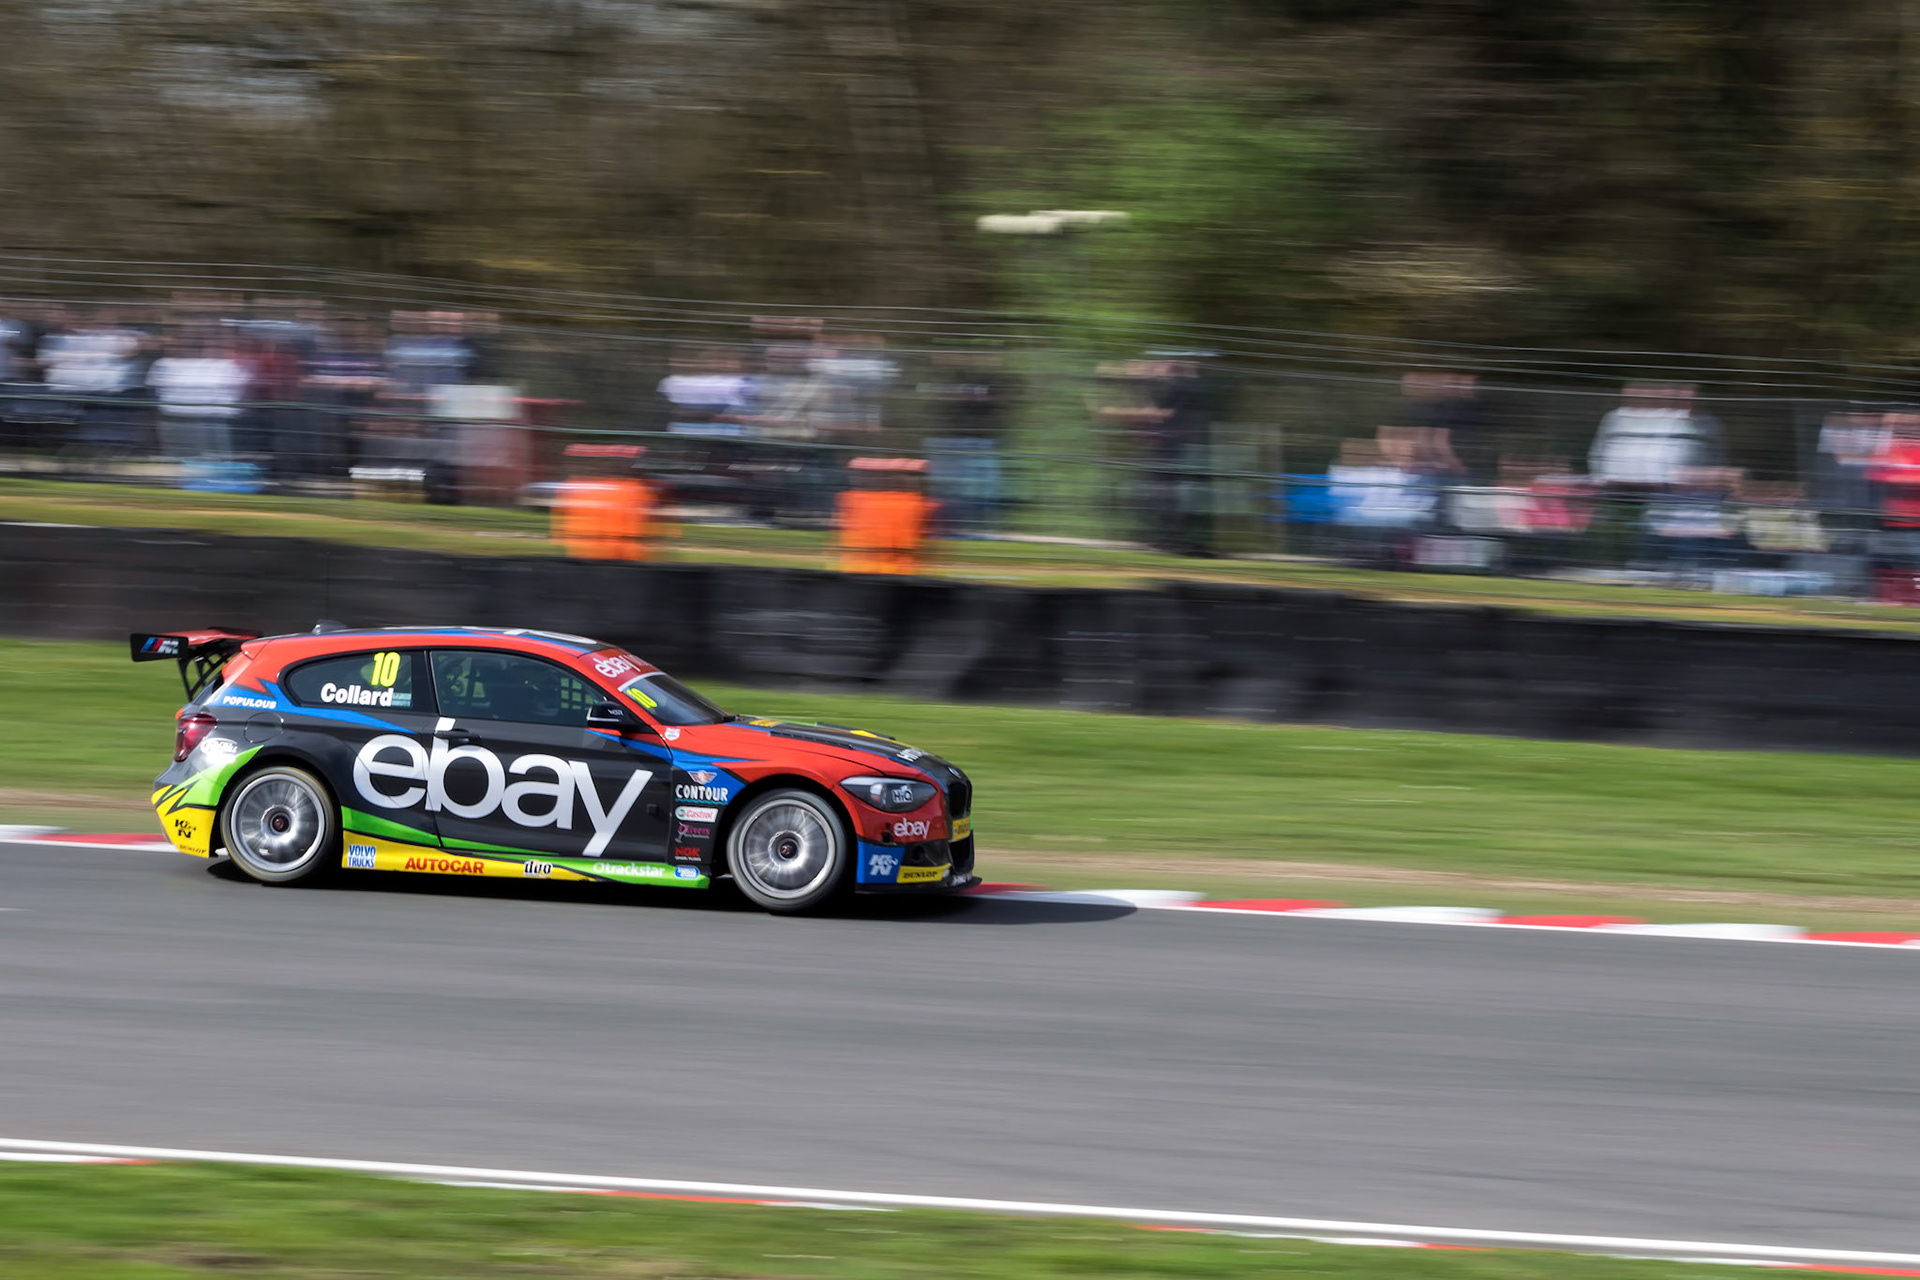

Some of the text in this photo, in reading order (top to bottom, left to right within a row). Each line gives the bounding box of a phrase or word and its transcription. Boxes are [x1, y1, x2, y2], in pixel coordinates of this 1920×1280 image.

[371, 652, 400, 687] 10
[593, 655, 641, 678] ebay
[223, 696, 277, 710] POPULOUS
[321, 683, 394, 707] Collard
[626, 688, 658, 709] 10
[353, 717, 653, 857] ebay
[675, 783, 728, 802] CONTOUR
[893, 817, 931, 839] ebay
[348, 845, 376, 856] VOLVO
[348, 856, 375, 868] TRUCKS
[404, 857, 485, 874] AUTOCAR
